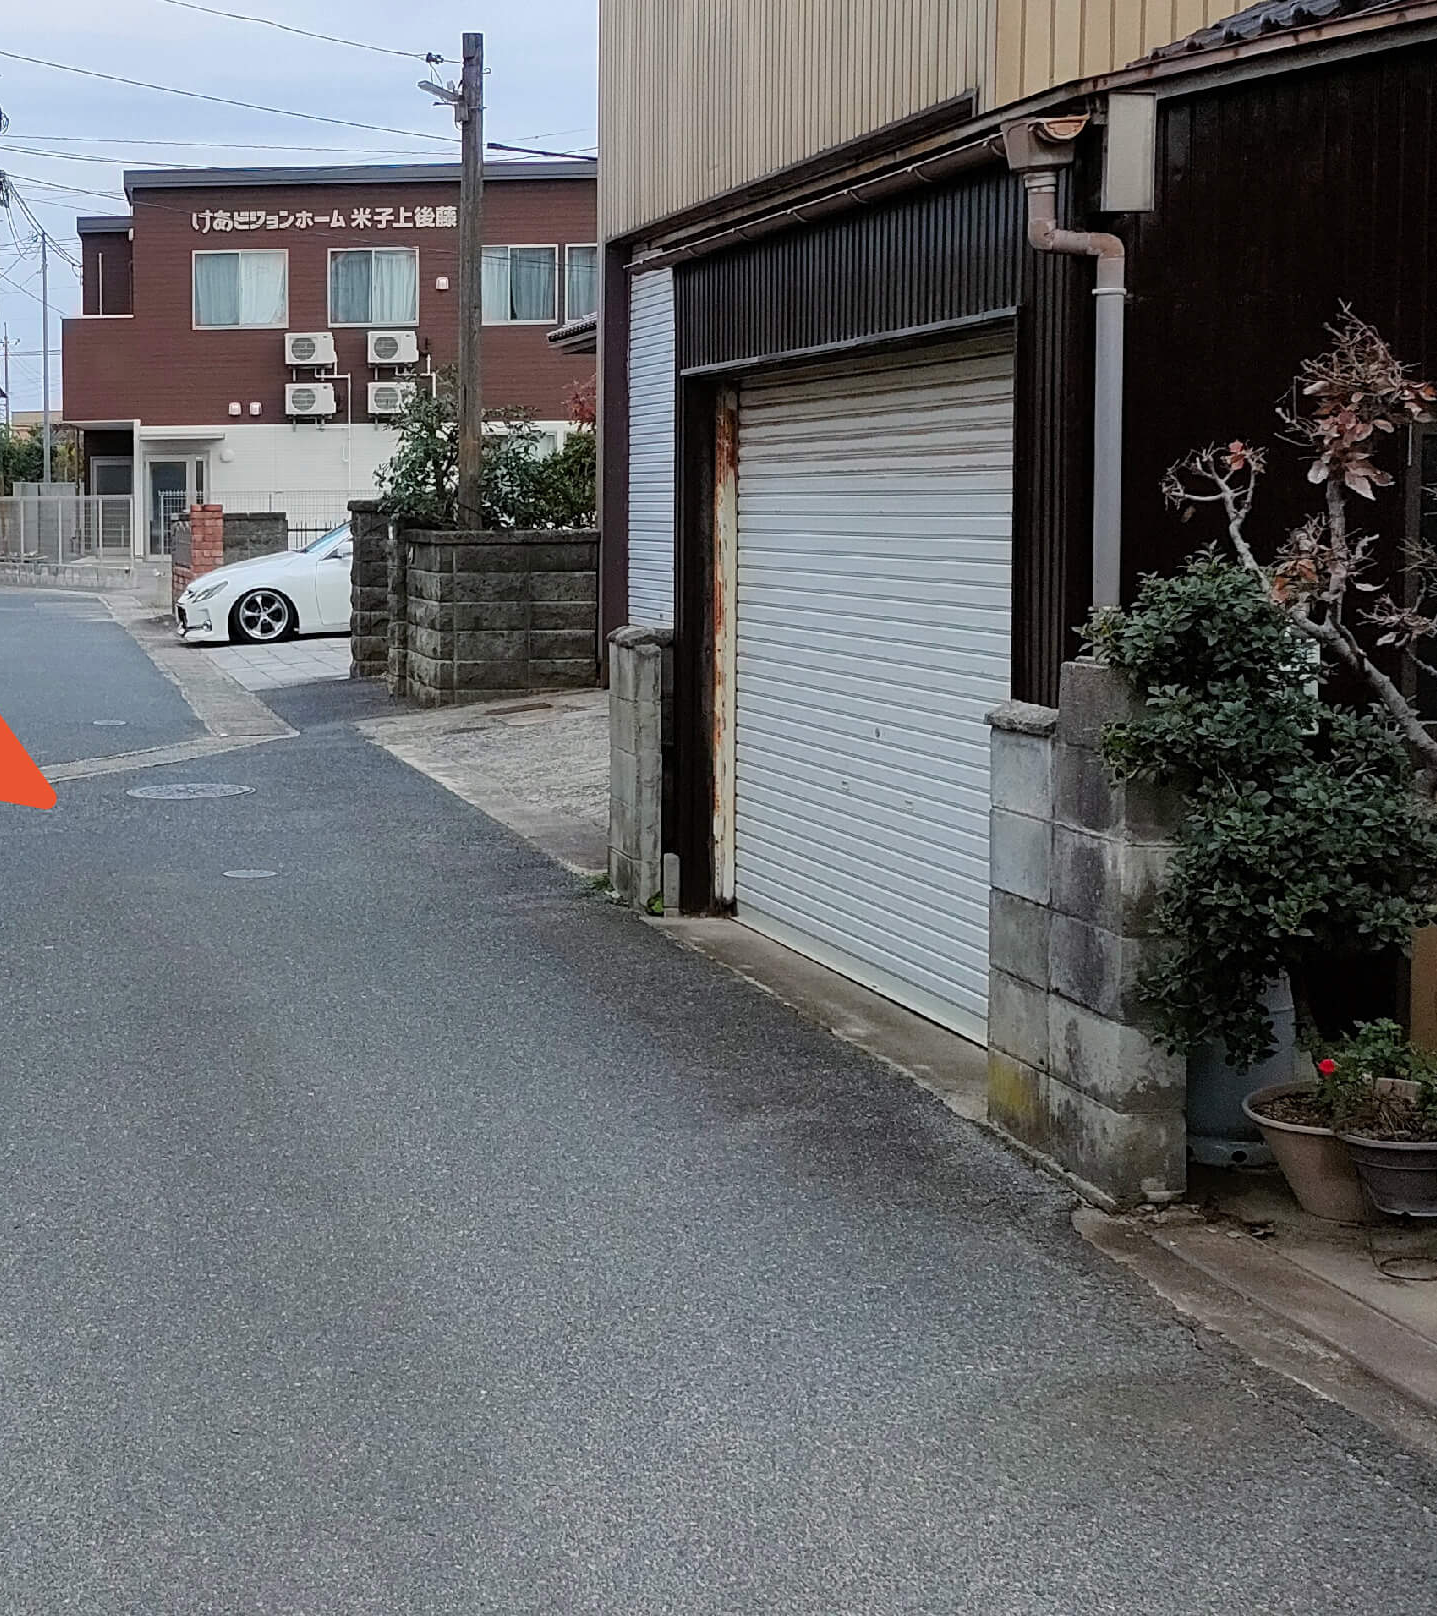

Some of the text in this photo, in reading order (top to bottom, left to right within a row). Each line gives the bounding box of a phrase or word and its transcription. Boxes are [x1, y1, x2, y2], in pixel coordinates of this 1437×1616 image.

[350, 206, 458, 229] 米子上後藤
